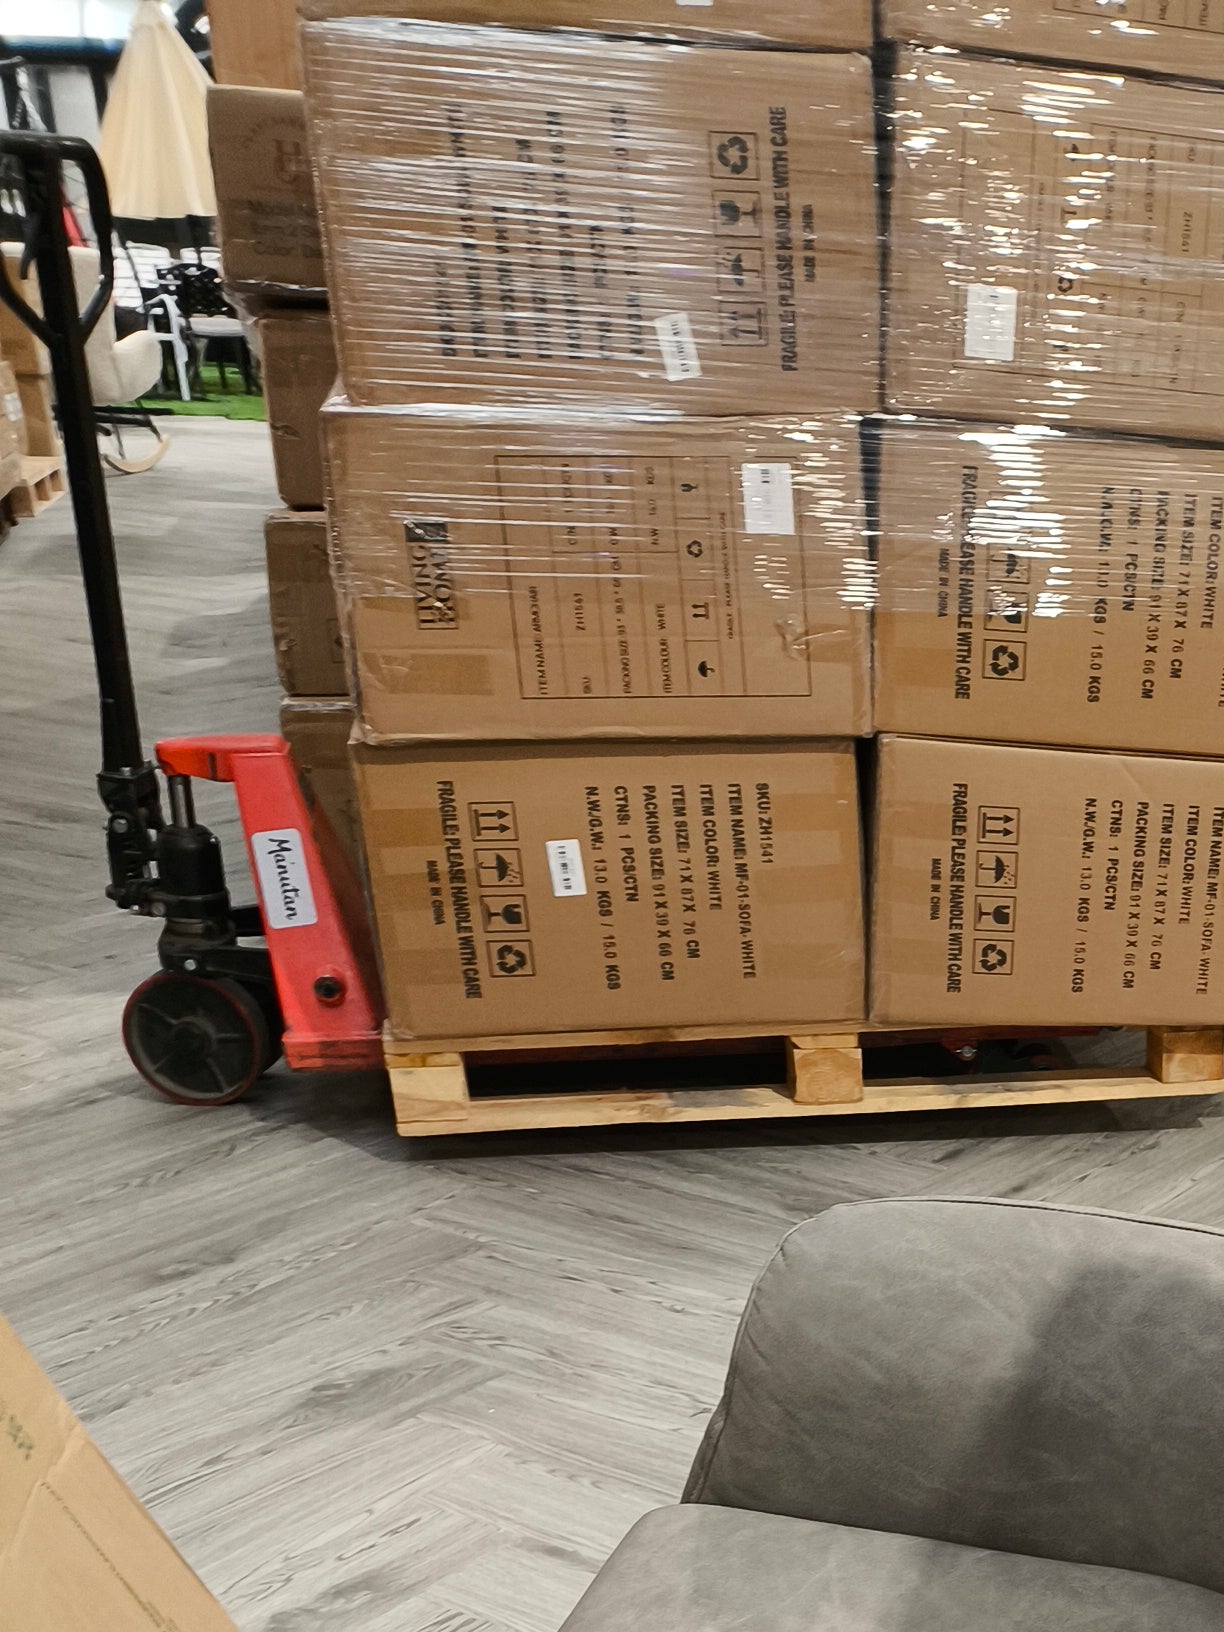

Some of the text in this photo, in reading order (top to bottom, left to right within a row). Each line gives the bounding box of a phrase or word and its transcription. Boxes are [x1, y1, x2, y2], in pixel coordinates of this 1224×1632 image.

[768, 106, 788, 148] CARE
[770, 150, 789, 189] WITH
[773, 191, 793, 251] HANDLE
[776, 254, 794, 306] PLEASE
[1210, 497, 1223, 531] ITEM
[937, 548, 950, 573] MADE
[410, 544, 436, 624] LIVING
[937, 591, 949, 619] CHINA
[1093, 597, 1108, 625] KGS
[1201, 586, 1218, 630] WHITE
[954, 578, 974, 700] HANDLE WITH CARE
[1174, 620, 1187, 630] X
[1090, 645, 1104, 671] 15.0
[1145, 643, 1158, 654] X
[1170, 658, 1183, 680] CM
[1087, 675, 1102, 703] KGS
[1141, 679, 1154, 700] CM
[613, 785, 632, 826] CTNS:
[671, 784, 687, 818] ITEM
[728, 783, 742, 816] ITEM
[756, 782, 770, 815] SKU:
[643, 785, 662, 846] PACKING
[1109, 800, 1123, 838] CTNS:
[1133, 801, 1149, 858] PACKING
[1160, 803, 1175, 835] ITEM
[1211, 807, 1224, 837] ITEM
[674, 820, 690, 854] SIZE:
[700, 784, 722, 911] ITEM COLOR: WHITE
[731, 817, 746, 860] NAME:
[1158, 837, 1173, 869] SIZE:
[594, 858, 608, 884] 13.0
[620, 847, 640, 903] PCS/CTN
[649, 847, 666, 881] SIZE:
[679, 857, 692, 872] 71
[1131, 860, 1145, 892] SIZE:
[1179, 805, 1201, 925] ITEM COLOR: WHITE
[1207, 840, 1222, 880] NAME:
[426, 859, 446, 925] MADE IN CHINA
[437, 780, 482, 1000] FRAGILE: PLEASE HANDLE WITH CARE
[680, 874, 694, 884] X
[930, 858, 942, 921] MADE IN CHINA
[946, 783, 968, 993] FRAGILE: PLEASE HANDLE WITH CARE
[1079, 867, 1092, 891] 13.0
[1104, 858, 1119, 912] PCS/CTN
[1156, 889, 1168, 898] X
[1157, 873, 1168, 887] 71
[596, 890, 612, 918] KGS
[655, 900, 669, 911] X
[683, 903, 696, 914] X
[1077, 897, 1091, 923] KGS
[1128, 911, 1140, 921] X
[658, 929, 672, 939] X
[1153, 917, 1165, 926] X
[687, 939, 701, 960] CM
[740, 939, 756, 979] WHITE
[1126, 940, 1138, 949] X
[606, 963, 621, 991] KGS
[661, 961, 675, 982] CM
[1149, 951, 1162, 971] CM
[1196, 957, 1210, 996] WHITE
[1071, 969, 1085, 994] KGS
[1123, 970, 1135, 989] CM
